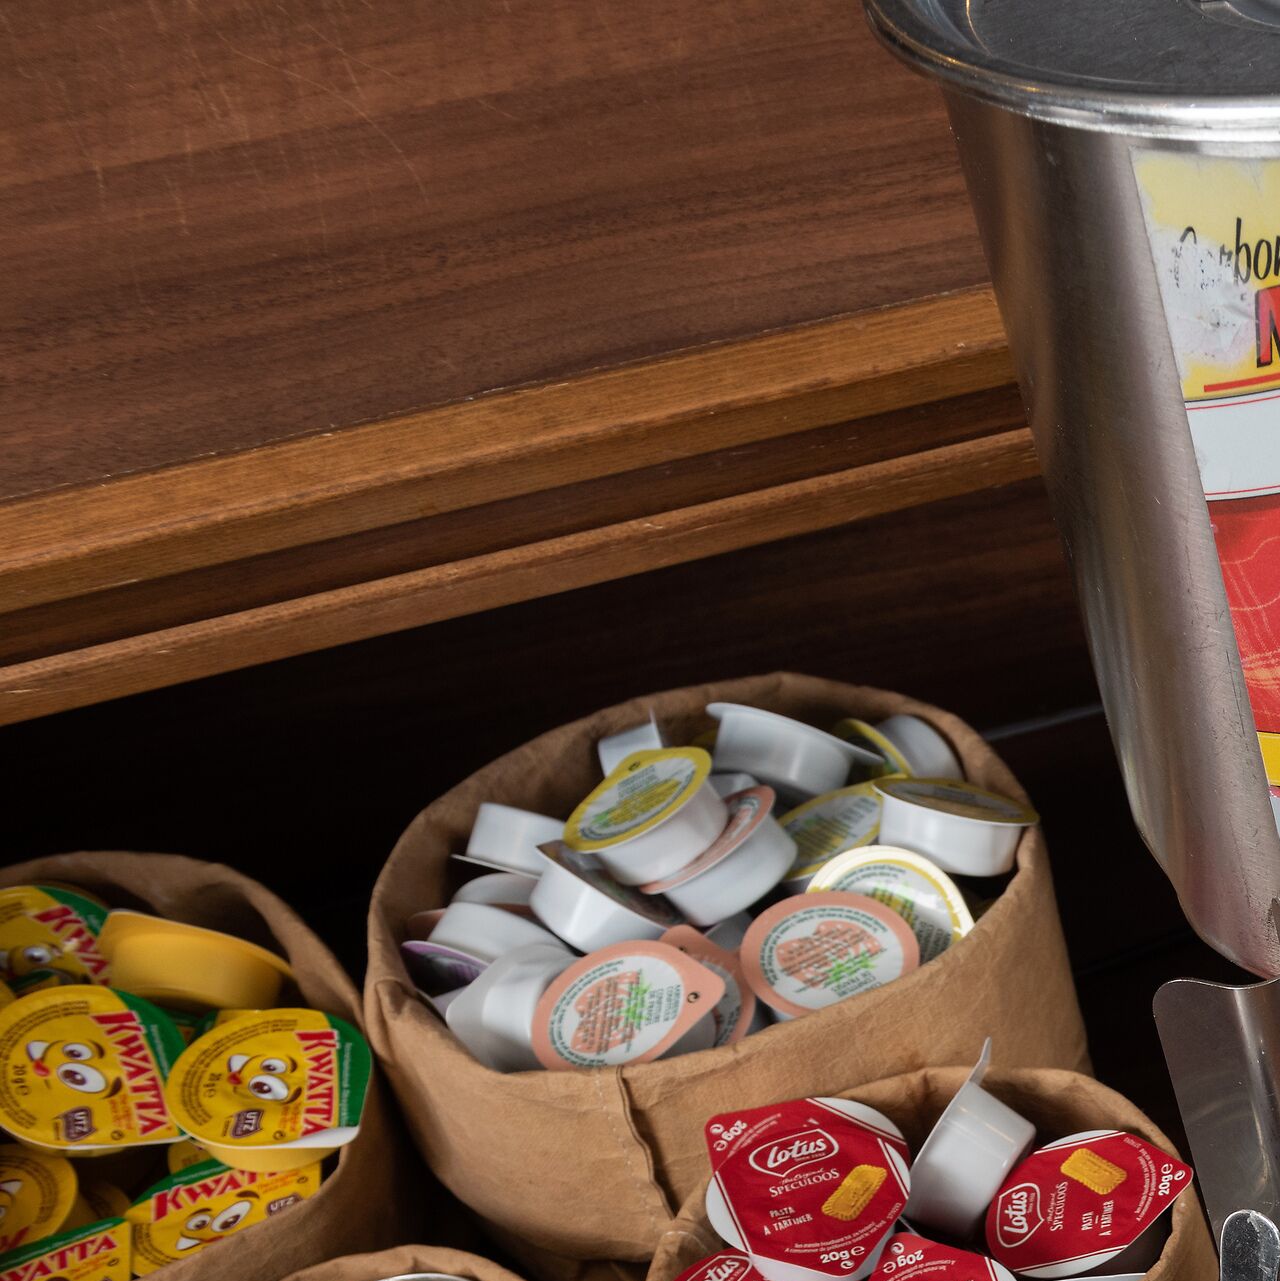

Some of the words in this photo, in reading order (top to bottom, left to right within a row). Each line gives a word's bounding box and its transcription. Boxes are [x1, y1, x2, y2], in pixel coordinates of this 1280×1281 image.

[90, 1010, 171, 1137] KWATTA
[294, 1030, 341, 1139] KWATTA
[766, 1137, 828, 1170] Lotus
[1157, 1173, 1174, 1197] 20g
[769, 1206, 796, 1218] PASTA
[773, 1213, 814, 1232] TARTINER
[1003, 1191, 1029, 1235] Lotus
[1081, 1210, 1095, 1231] PASTA
[1100, 1199, 1115, 1229] TARTINER
[819, 1250, 851, 1265] 20g
[896, 1249, 925, 1268] 20g
